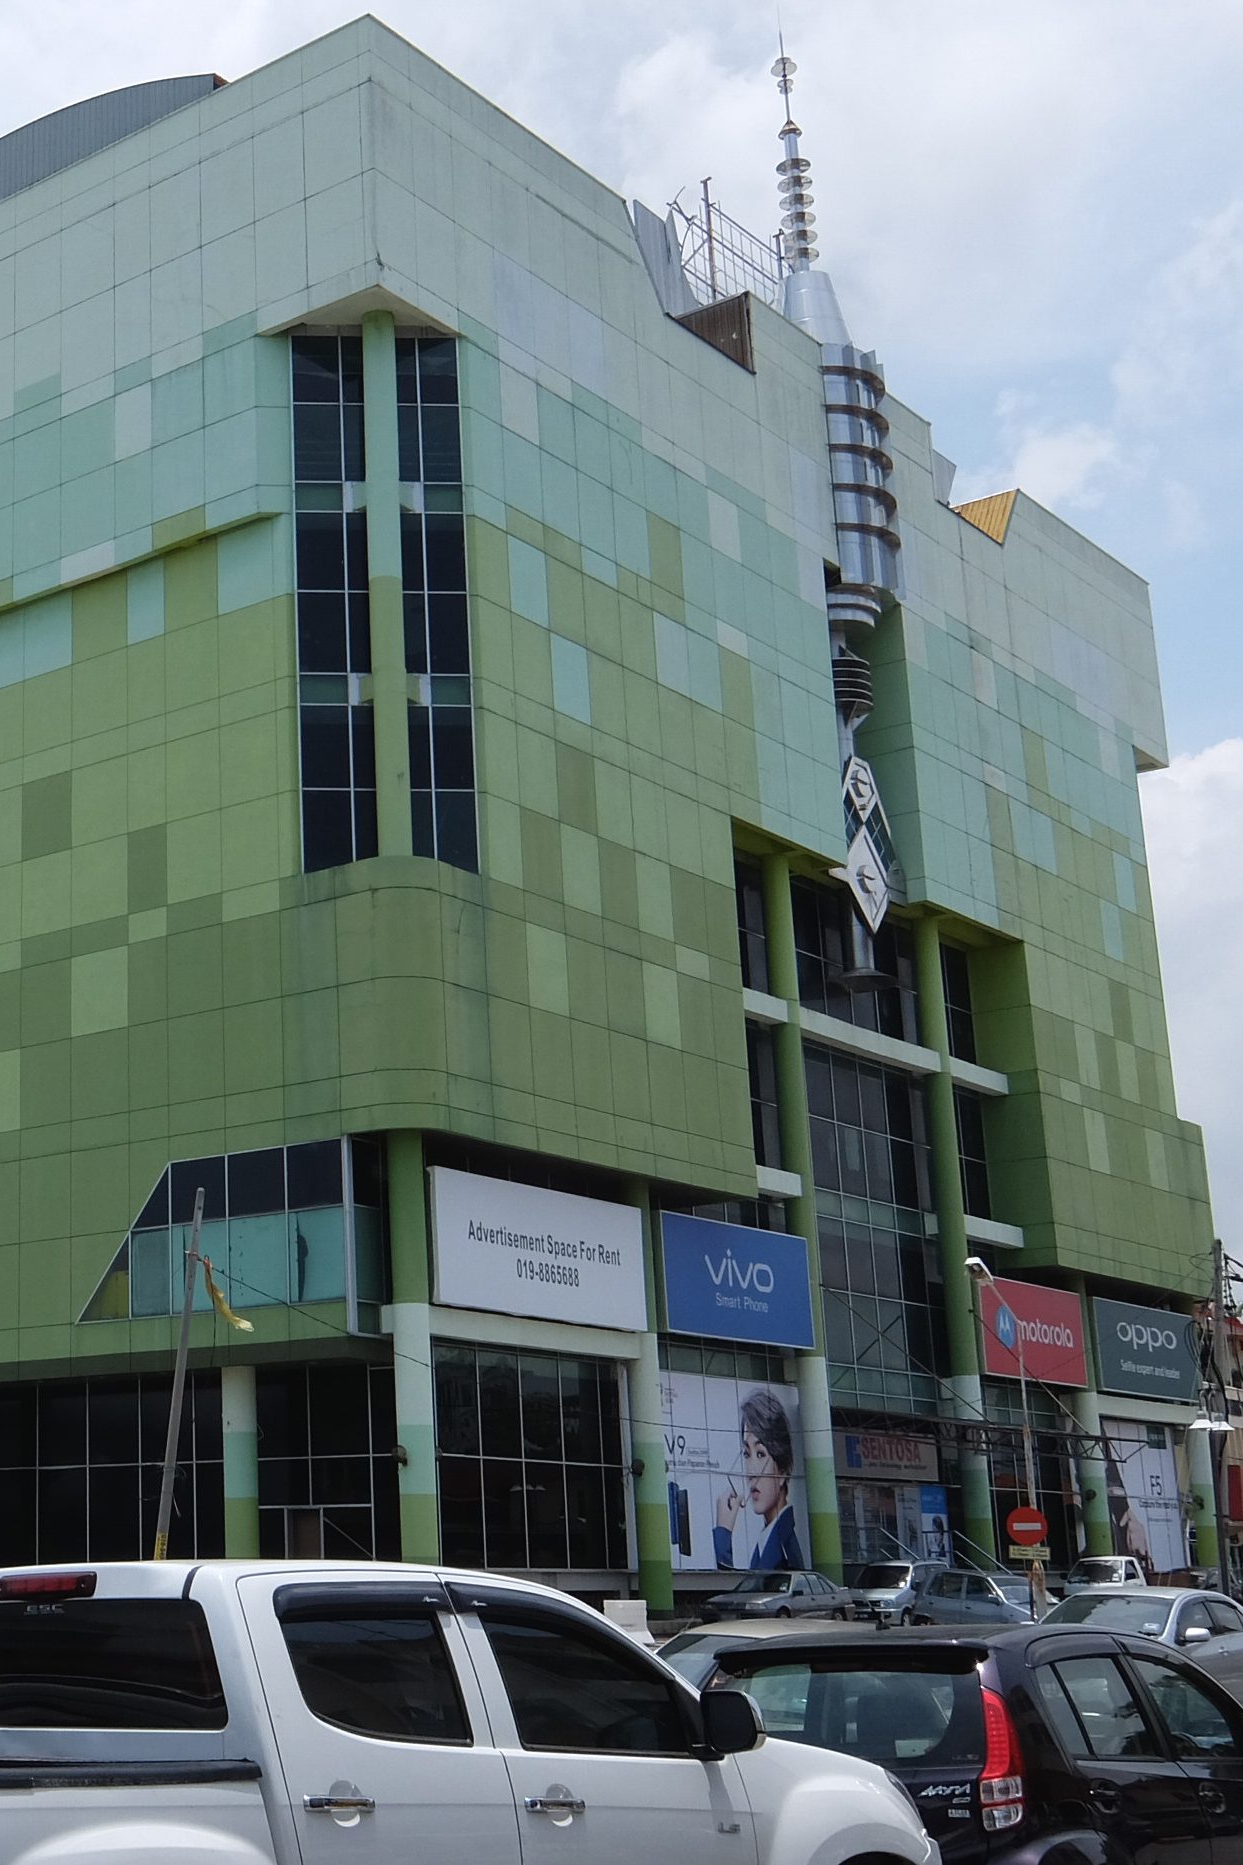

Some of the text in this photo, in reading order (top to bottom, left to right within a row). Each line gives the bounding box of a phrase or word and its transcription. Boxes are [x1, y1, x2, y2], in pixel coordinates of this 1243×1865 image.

[468, 1219, 622, 1266] Advertisement Space For Rent
[516, 1258, 580, 1287] 019-8865688
[704, 1248, 774, 1293] vivo
[716, 1292, 769, 1313] Smart Phone
[1019, 1318, 1074, 1348] motorola
[1117, 1322, 1177, 1353] oppo
[664, 1433, 686, 1456] V9
[860, 1436, 922, 1462] SENTOSA
[1149, 1475, 1163, 1496] F5
